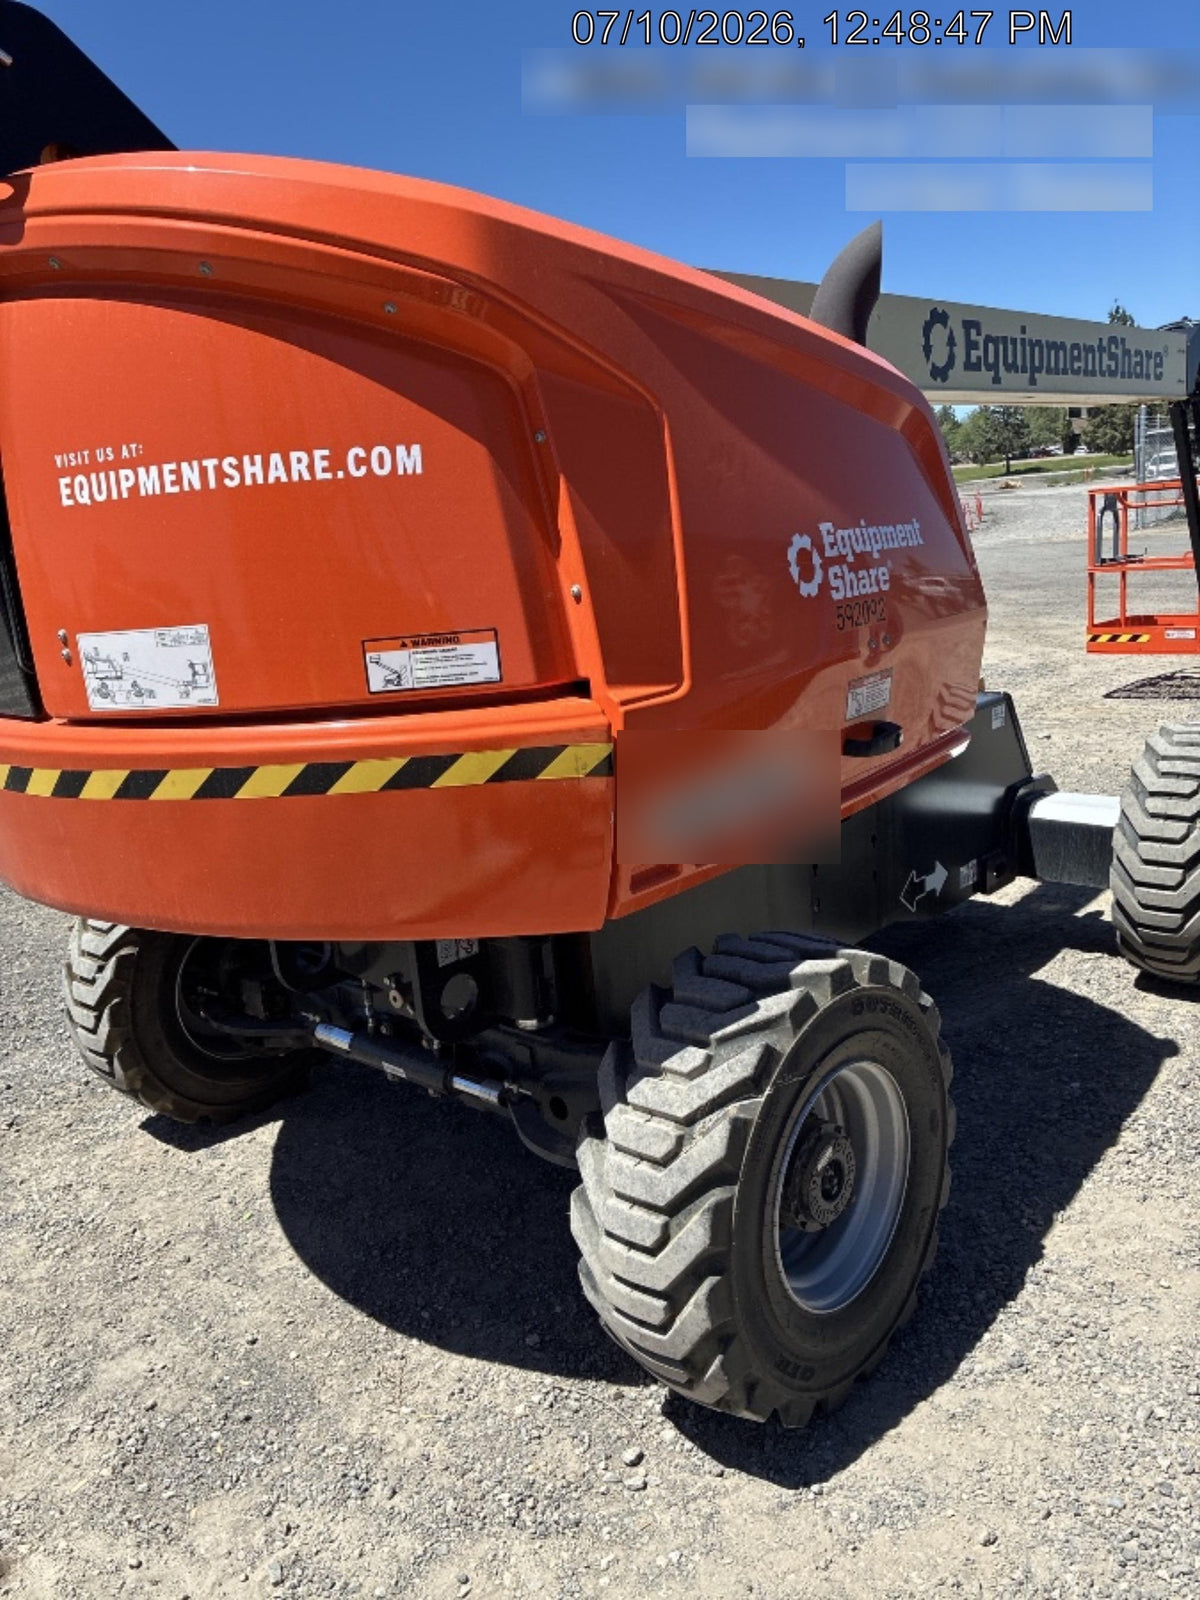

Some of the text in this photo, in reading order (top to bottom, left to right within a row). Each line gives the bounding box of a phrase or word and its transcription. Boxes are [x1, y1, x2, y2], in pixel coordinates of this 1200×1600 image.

[54, 443, 144, 468] VISIT US AT:
[58, 444, 423, 507] EQUIPMENTSHARE.COM
[818, 518, 924, 562] Equipment
[828, 564, 891, 600] Share
